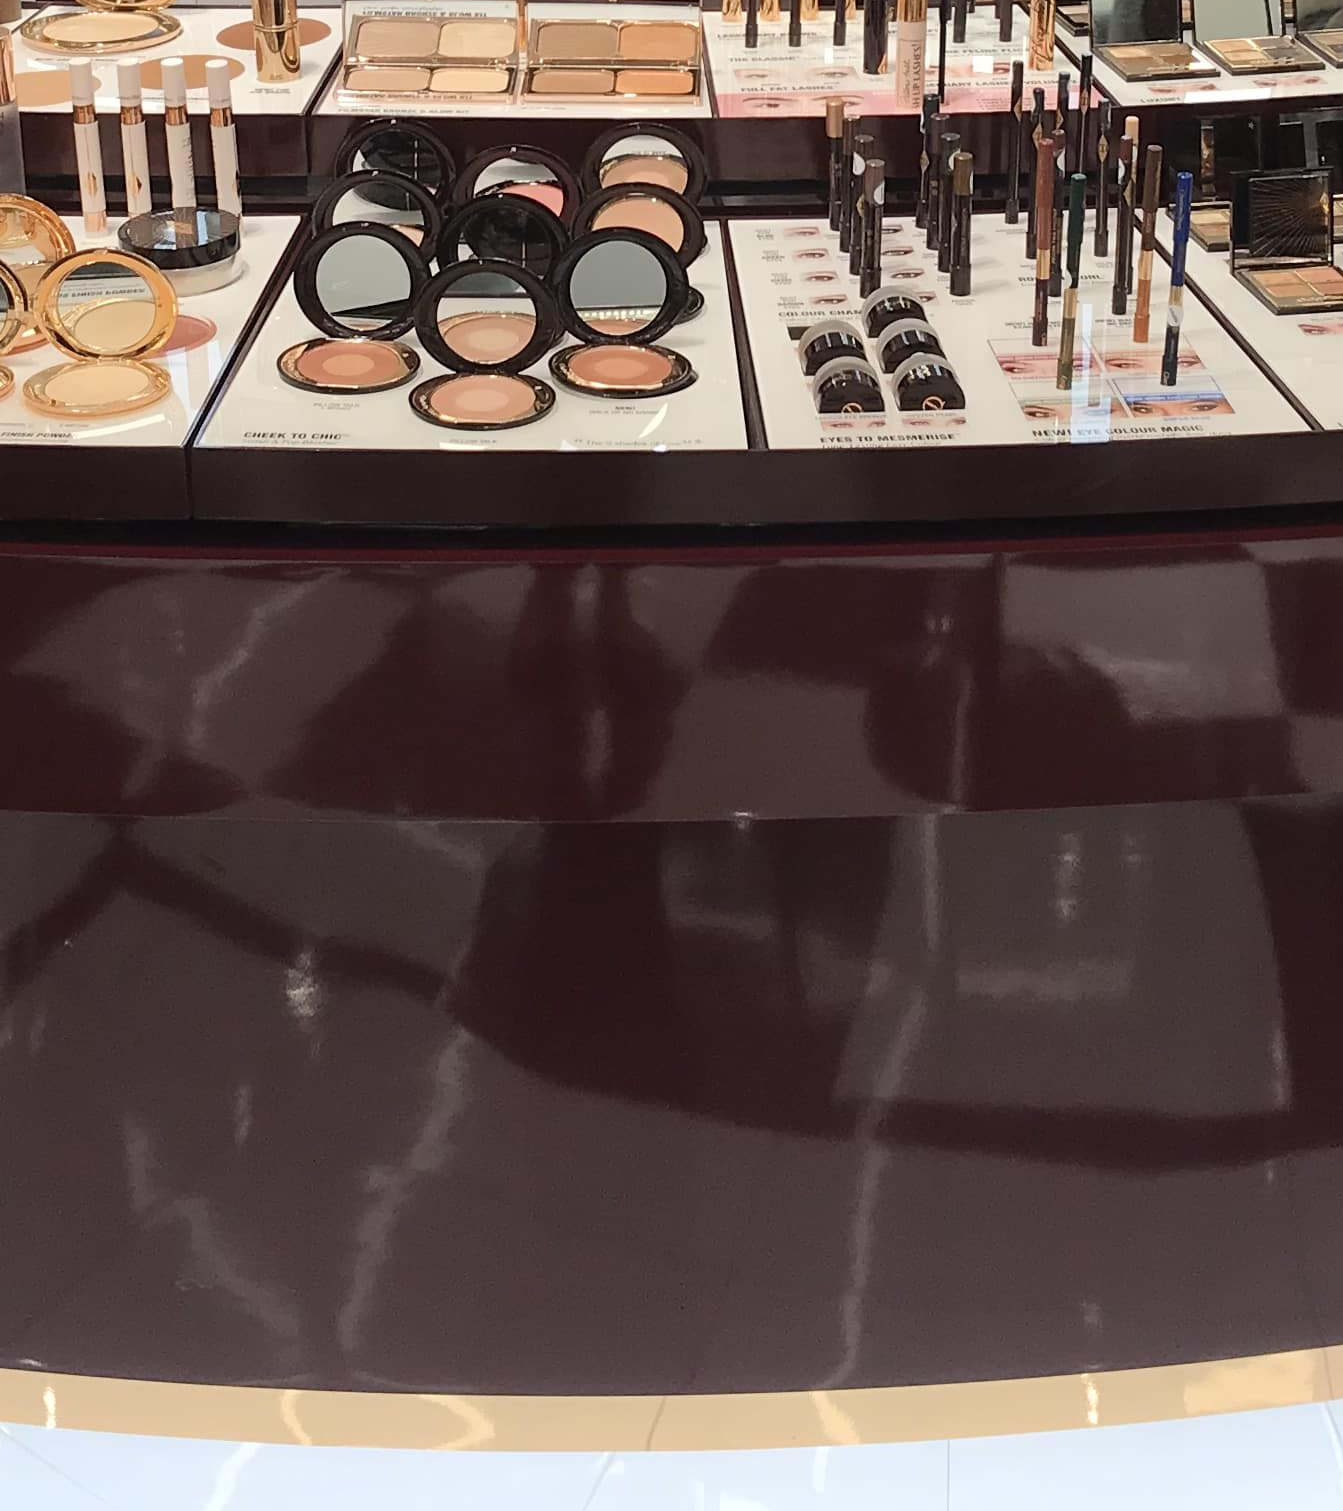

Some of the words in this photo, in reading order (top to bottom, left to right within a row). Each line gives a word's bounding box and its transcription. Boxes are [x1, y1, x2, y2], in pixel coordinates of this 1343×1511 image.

[1105, 426, 1157, 435] COLOUR
[1161, 424, 1205, 433] MAGIC
[243, 431, 287, 440] CHEEK
[291, 432, 308, 440] TO
[820, 435, 853, 444] EYES
[857, 435, 873, 443] TO
[877, 432, 956, 442] MESMERISE
